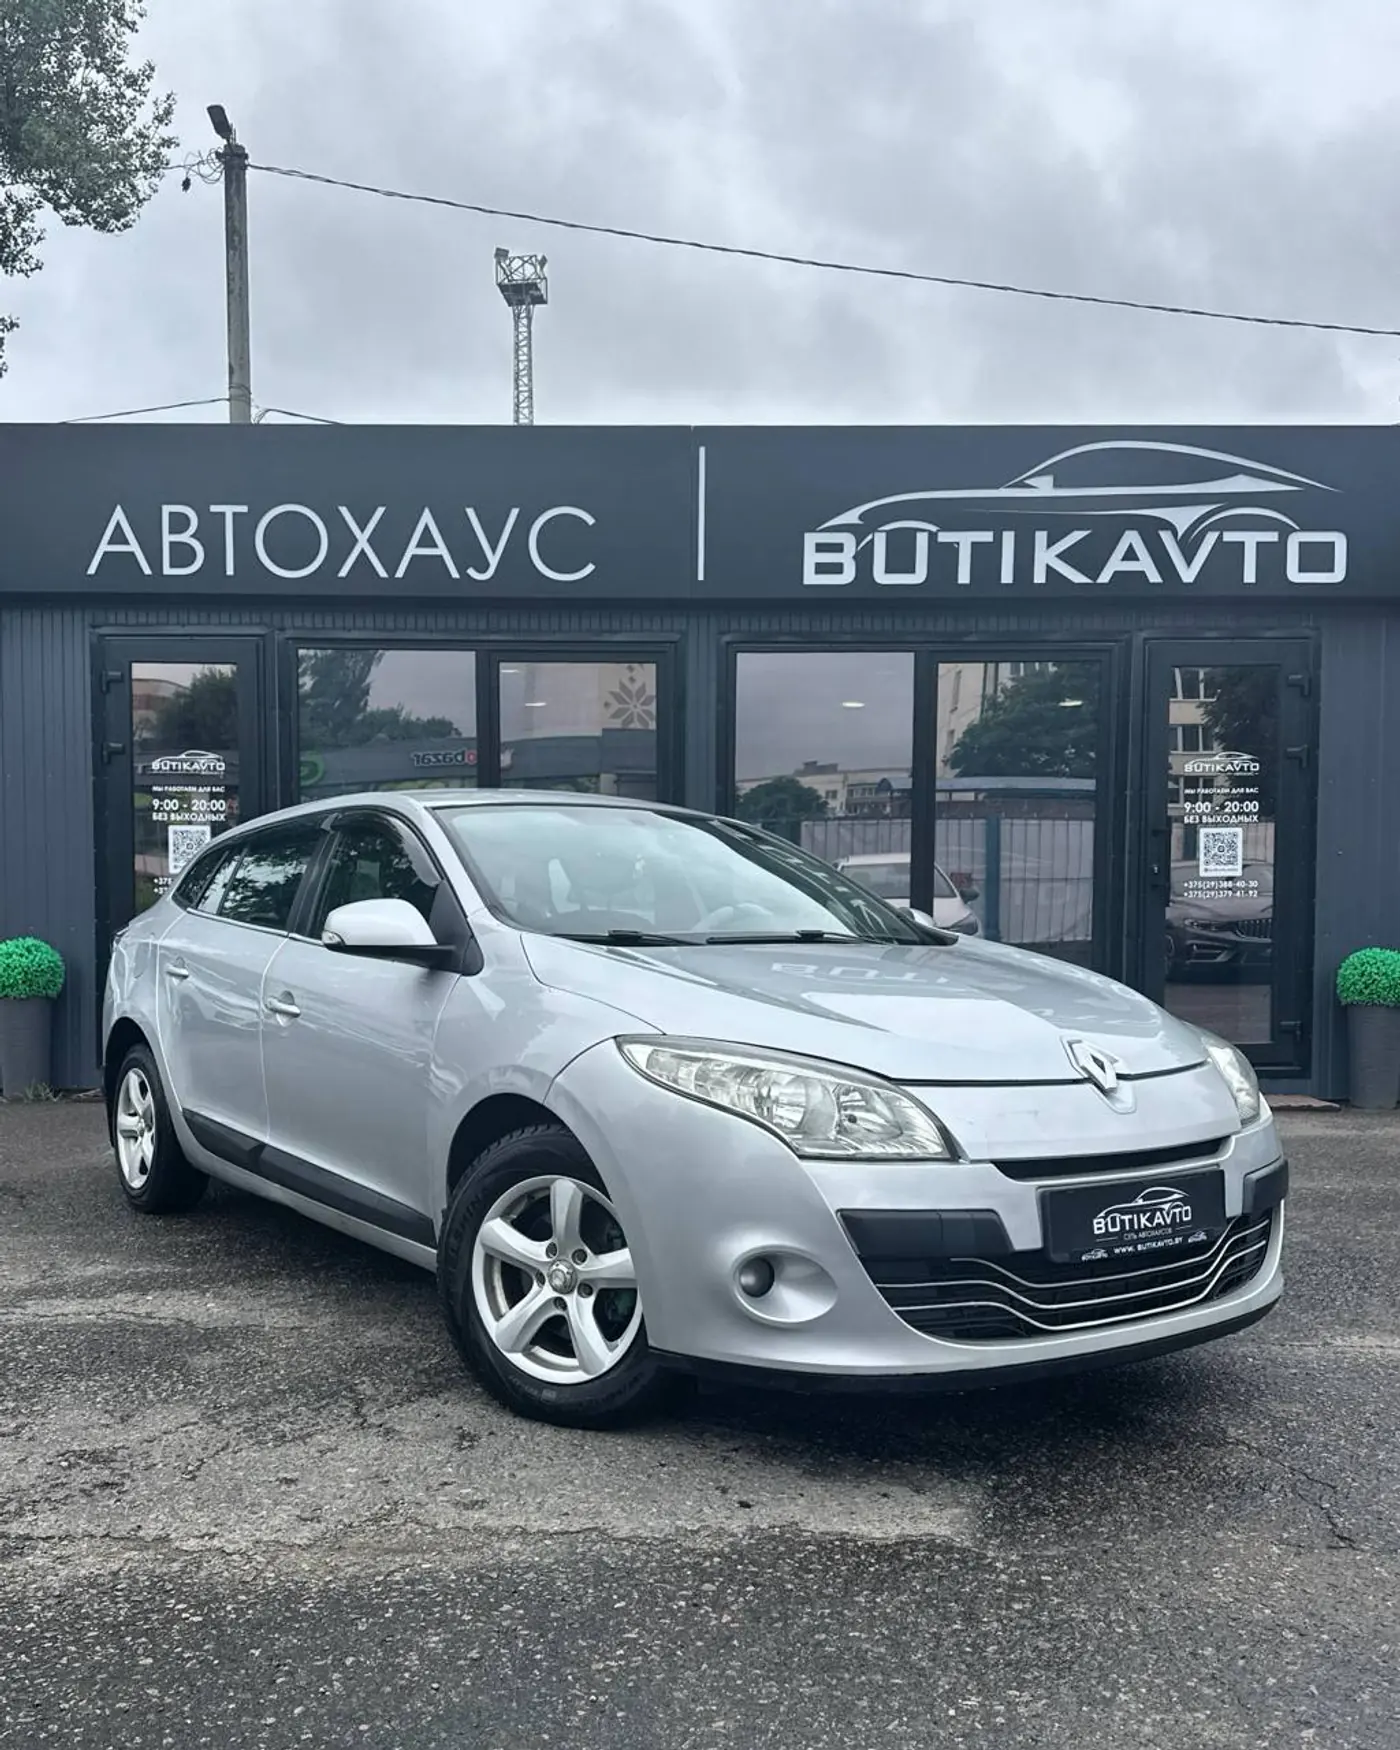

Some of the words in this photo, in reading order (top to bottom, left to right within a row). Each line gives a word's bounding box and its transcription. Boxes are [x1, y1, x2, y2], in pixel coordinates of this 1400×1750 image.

[86, 503, 597, 582] АВТОХАУС
[802, 529, 1348, 586] BUTIKAVTO
[151, 760, 226, 771] BUTIKAVTO
[1183, 762, 1260, 773] BUTIKAVTO
[152, 799, 179, 811] 9:00
[191, 799, 226, 811] 20:00
[1183, 801, 1212, 813] 9:00
[1223, 800, 1259, 813] 20:00
[152, 812, 168, 821] БЕЗ
[170, 812, 226, 822] ВЫХОДНЫХ
[1183, 815, 1200, 824] БЕЗ
[1202, 814, 1259, 824] ВЫХОДНЫХ
[1092, 1205, 1192, 1235] BUTIKAVTO
[1137, 1236, 1184, 1251] BUTIKAVTO.BY
